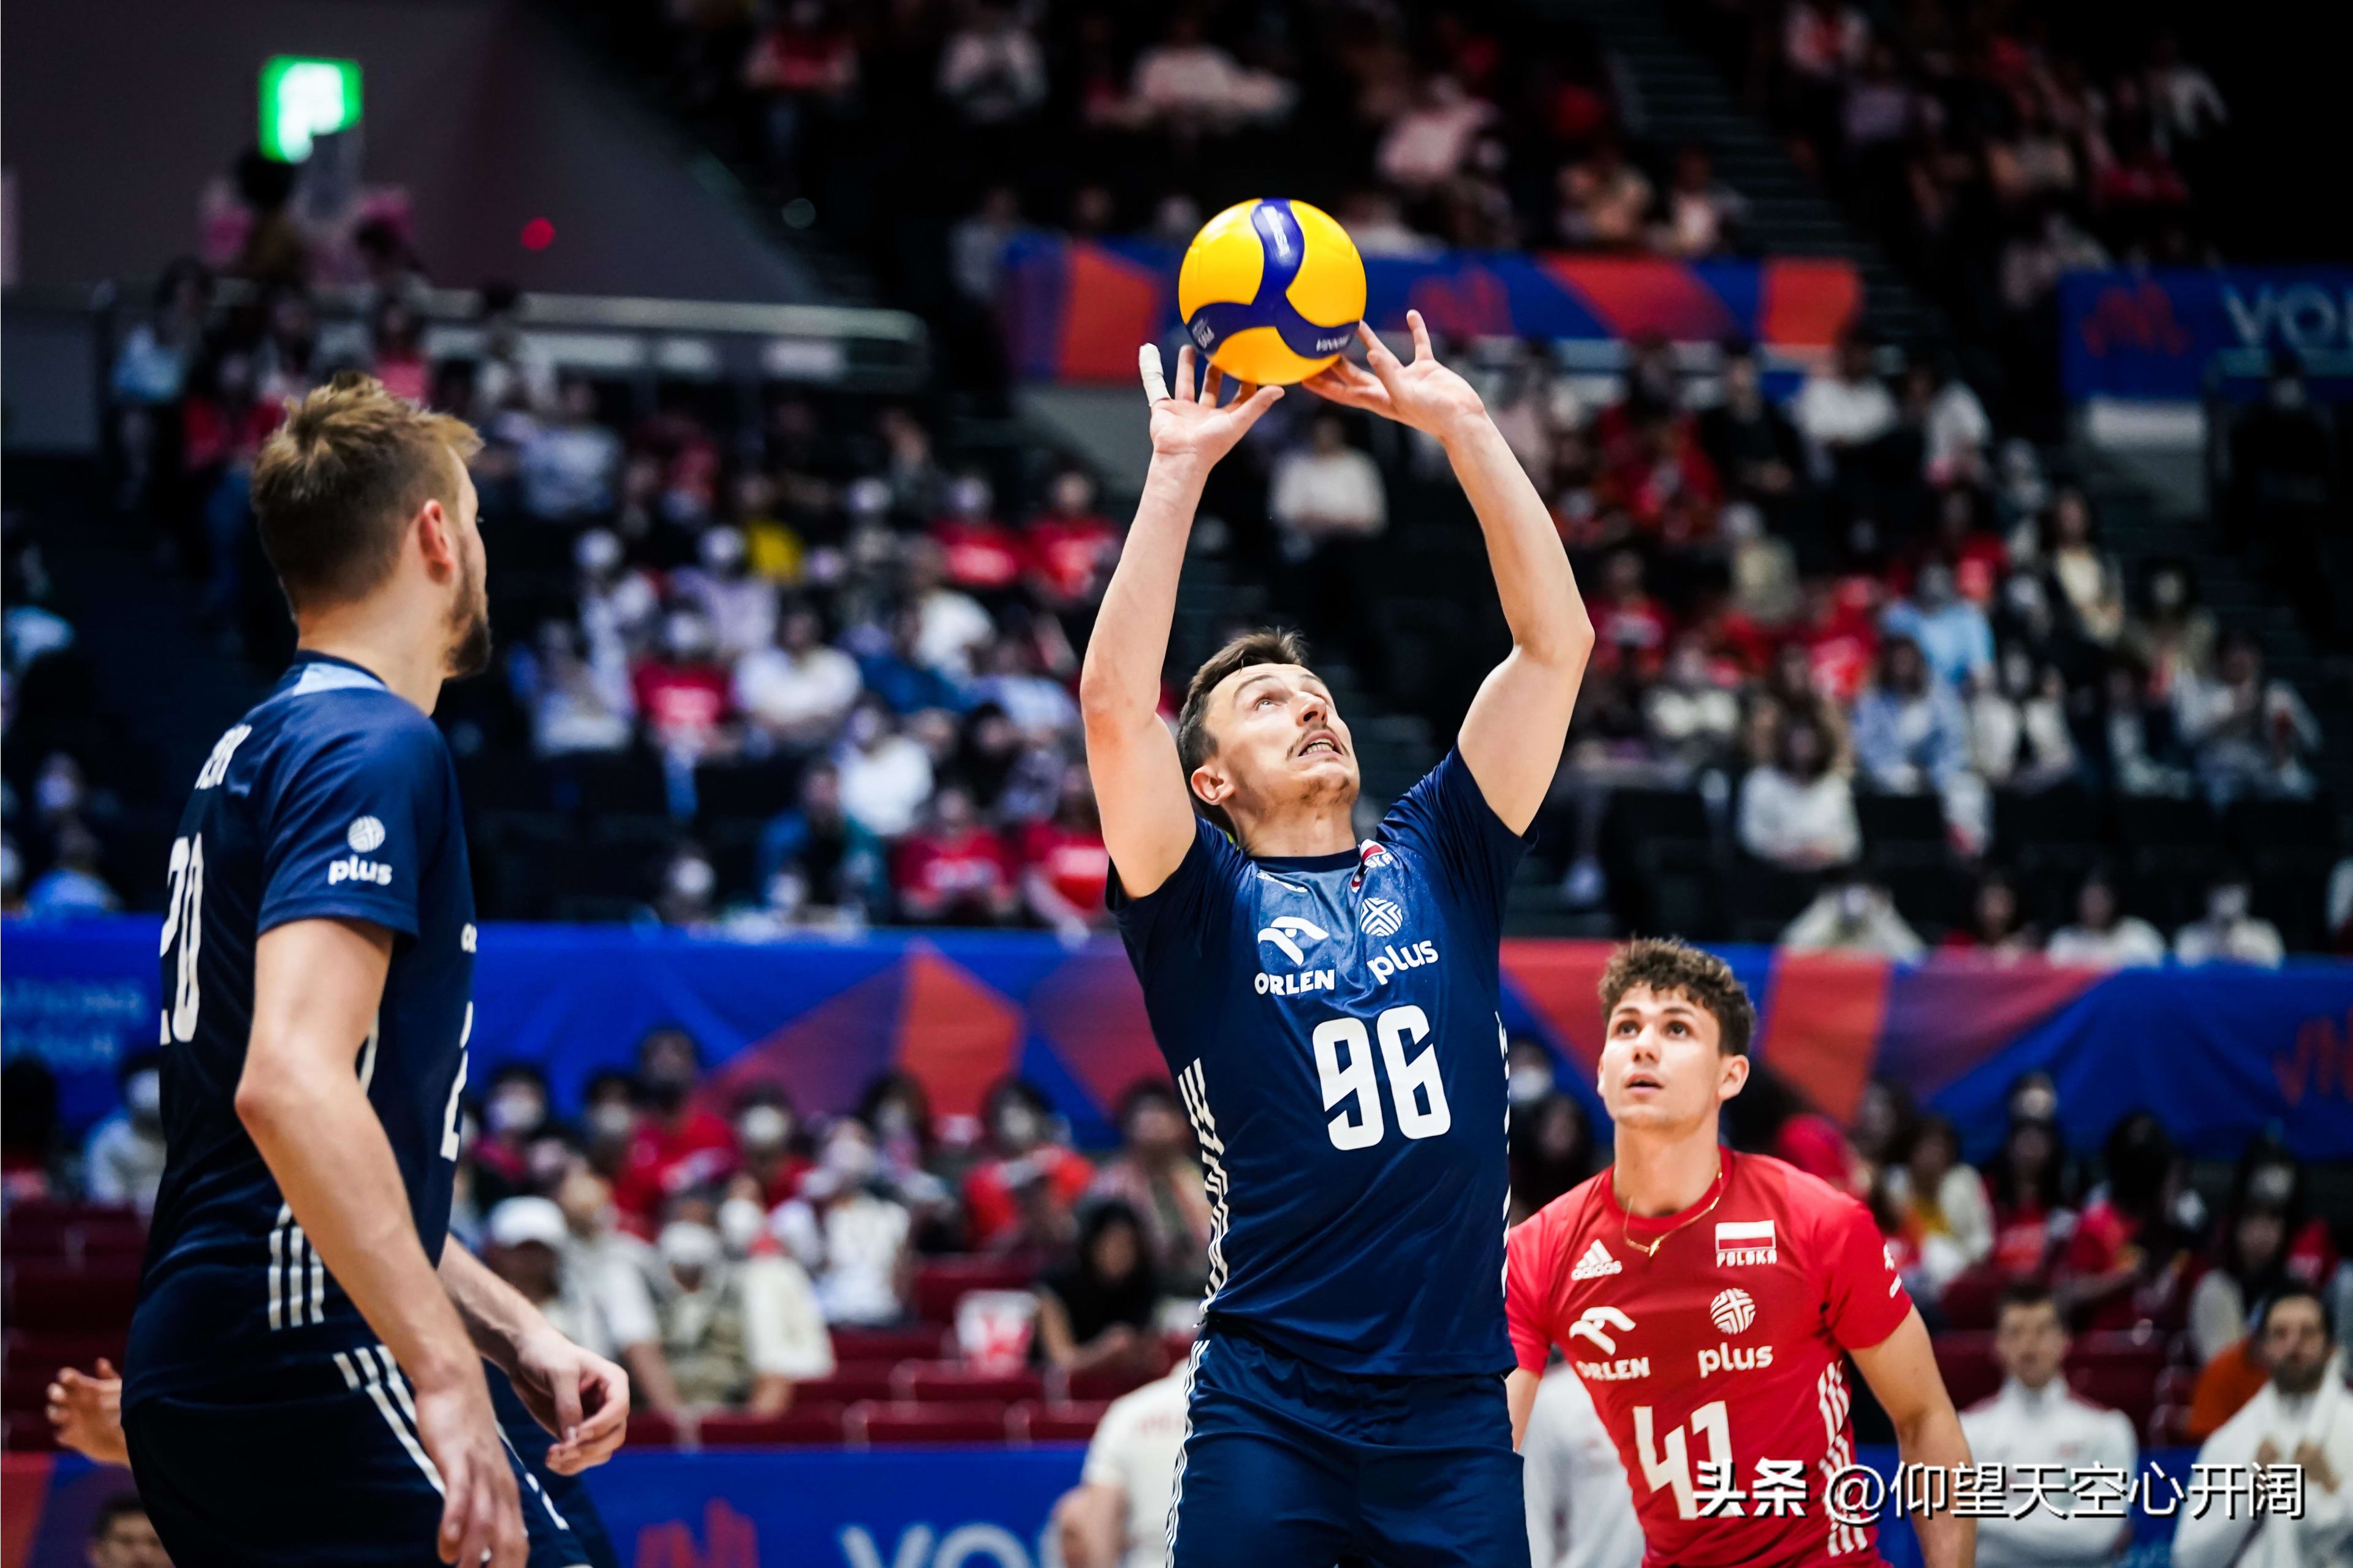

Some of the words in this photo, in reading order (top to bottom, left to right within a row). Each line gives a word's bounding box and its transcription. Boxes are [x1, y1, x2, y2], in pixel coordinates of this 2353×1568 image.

[328, 855, 393, 885] plus
[1366, 940, 1439, 985] plus
[1254, 968, 1336, 996] ORLEN
[1312, 1005, 1452, 1151] 96
[1571, 1260, 1623, 1281] adidas
[1716, 1249, 1778, 1268] POLSKA
[1697, 1342, 1774, 1379] plus
[1632, 1399, 1737, 1520] 41
